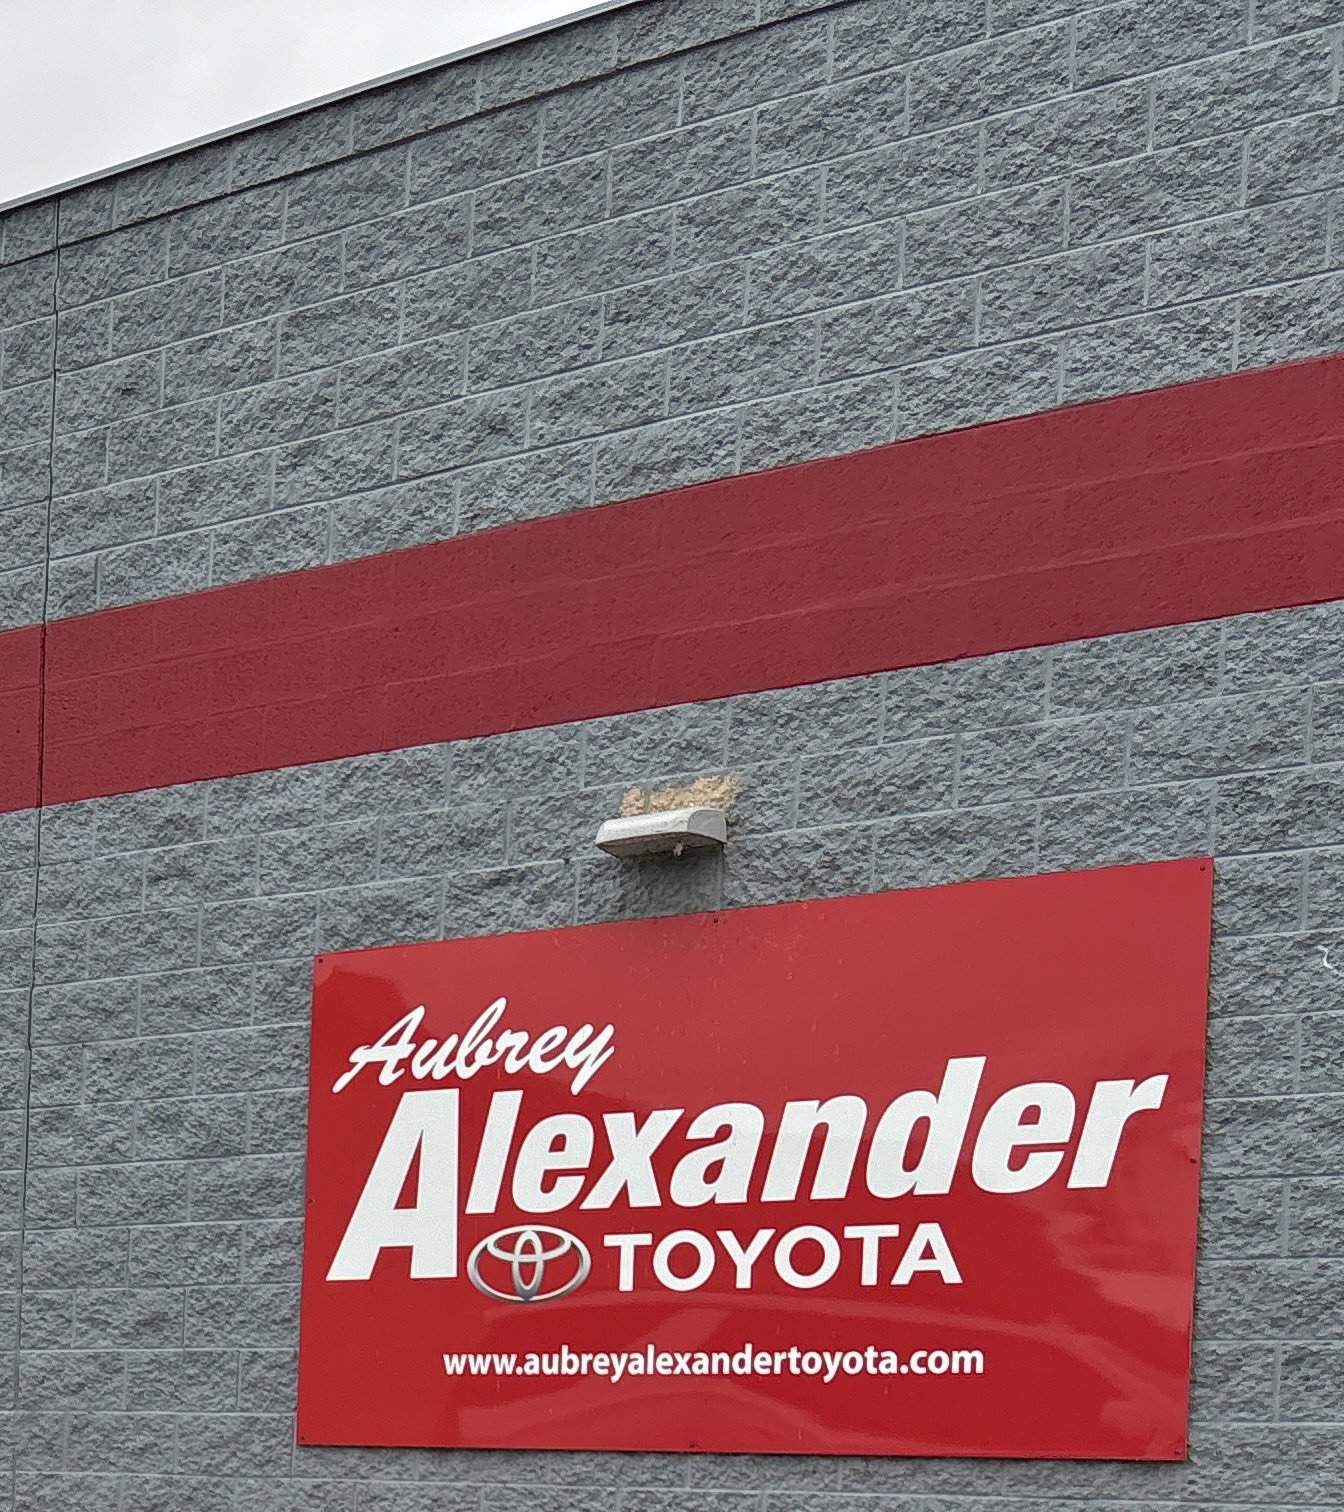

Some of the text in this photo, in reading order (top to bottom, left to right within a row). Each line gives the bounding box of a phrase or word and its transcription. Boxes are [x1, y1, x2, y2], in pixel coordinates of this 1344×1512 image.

[332, 997, 615, 1094] Aubrey
[325, 1055, 1169, 1282] Alexander
[603, 1222, 963, 1292] TOYOTA
[442, 1343, 984, 1384] www.aubreyalexandertoyota.com
